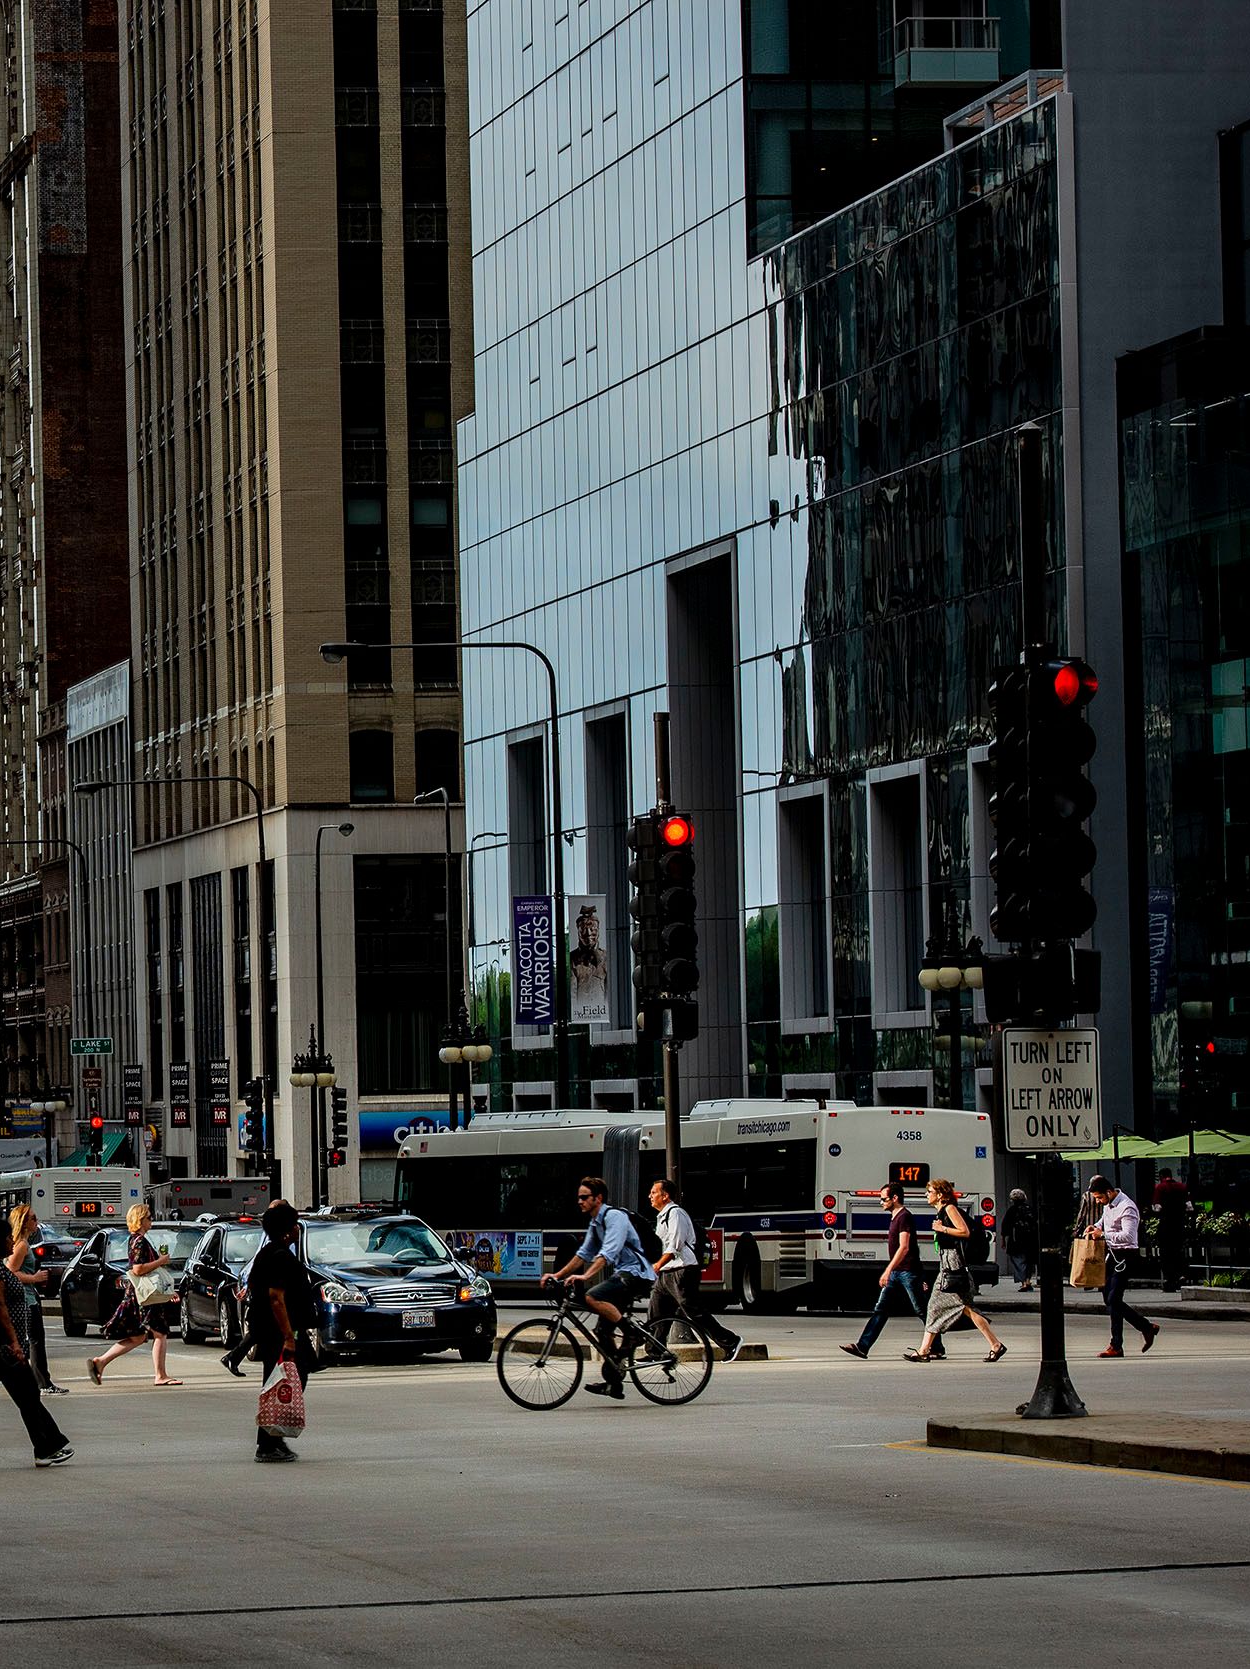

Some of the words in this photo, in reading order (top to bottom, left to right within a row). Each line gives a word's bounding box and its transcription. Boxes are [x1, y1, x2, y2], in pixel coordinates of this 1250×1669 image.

[519, 922, 533, 1014] TERRACOTTA
[533, 916, 551, 1019] WARRIORS
[583, 1005, 606, 1016] Field
[80, 1040, 101, 1048] LAKE
[1011, 1042, 1049, 1064] TURN
[1056, 1042, 1092, 1064] LEFT
[1042, 1068, 1062, 1084] ON
[1012, 1089, 1042, 1110] LEFT
[1049, 1088, 1093, 1110] ARROW
[394, 1119, 465, 1144] citib
[737, 1120, 791, 1136] transitchicago.com
[1026, 1115, 1081, 1137] ONLY
[897, 1131, 922, 1141] 4358
[899, 1166, 920, 1181] 147
[81, 1203, 95, 1212] 143
[178, 1198, 203, 1207] GARDA
